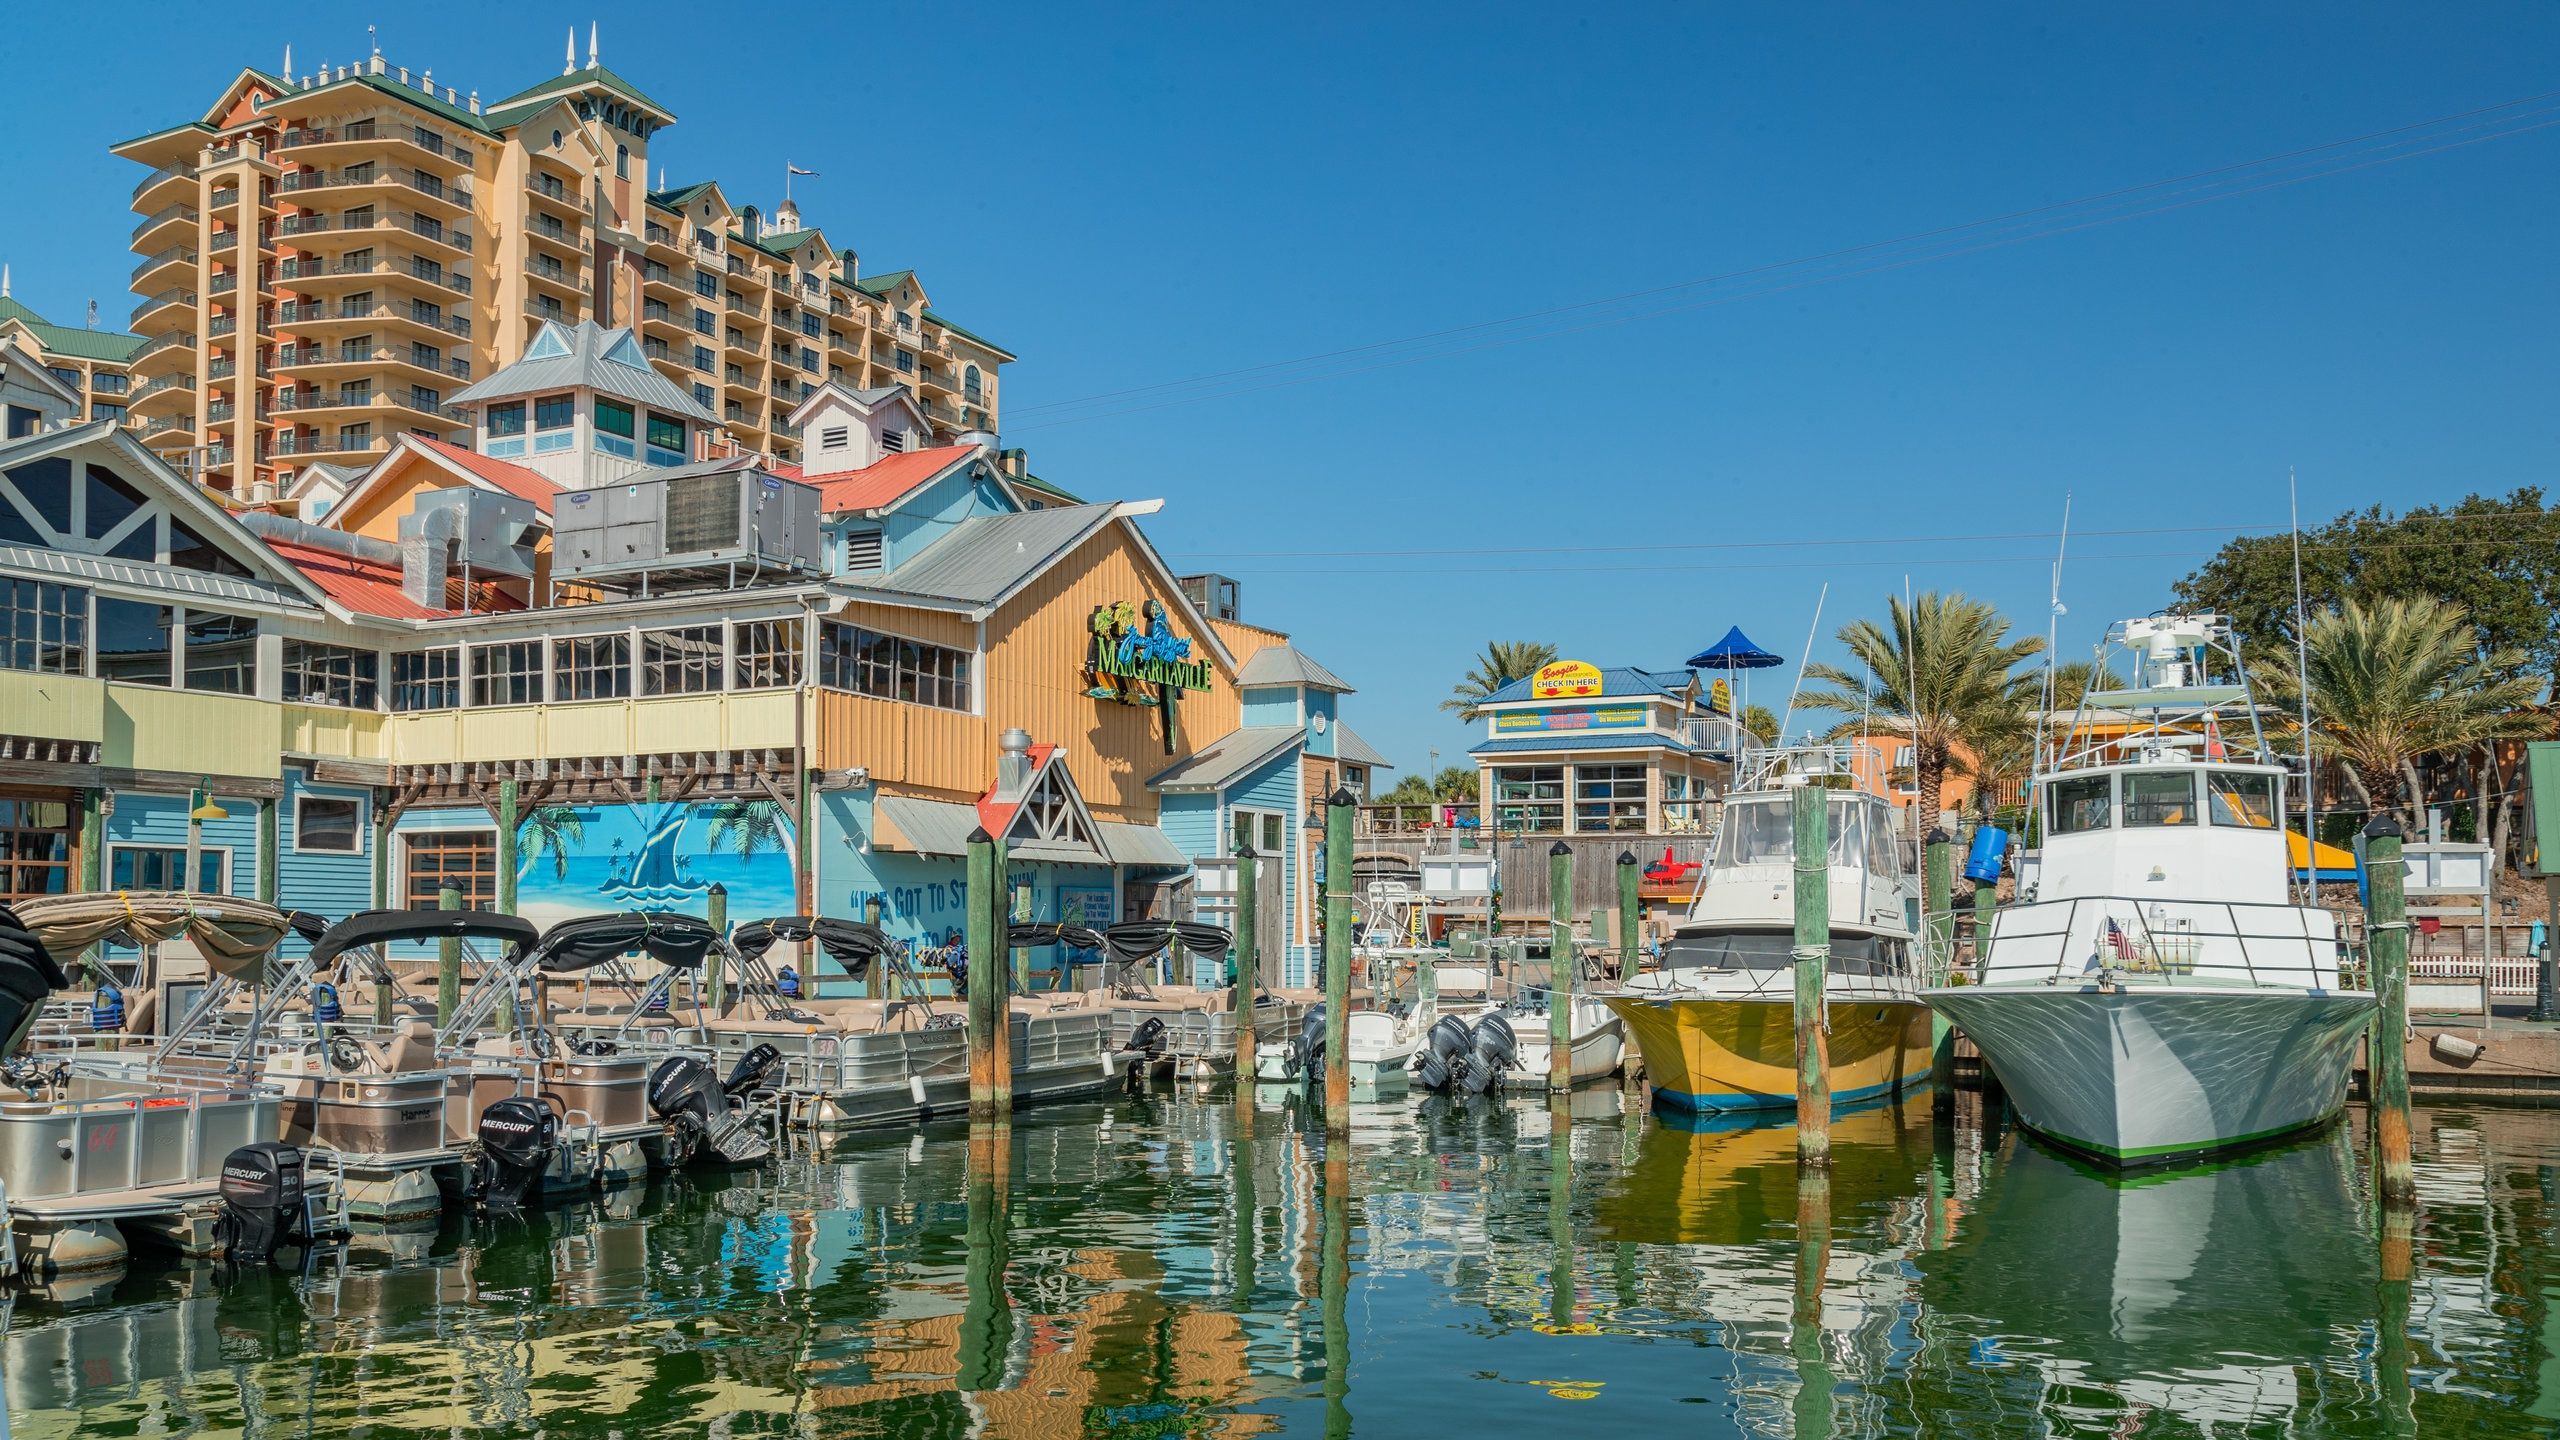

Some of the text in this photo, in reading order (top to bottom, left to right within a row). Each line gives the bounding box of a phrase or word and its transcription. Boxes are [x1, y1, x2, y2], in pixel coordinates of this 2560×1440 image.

[1541, 664, 1579, 680] Boogies
[1536, 677, 1599, 688] CHECK IN HERE
[894, 886, 922, 919] GOT
[927, 883, 945, 913] TO
[650, 1032, 665, 1044] 49
[819, 1040, 835, 1056] 38
[653, 1060, 688, 1101] MERCURY
[401, 1109, 432, 1122] Harris
[480, 1119, 535, 1133] MERCURY
[87, 1123, 118, 1153] 64
[223, 1166, 268, 1180] MERCURY
[282, 1175, 298, 1186] 50
